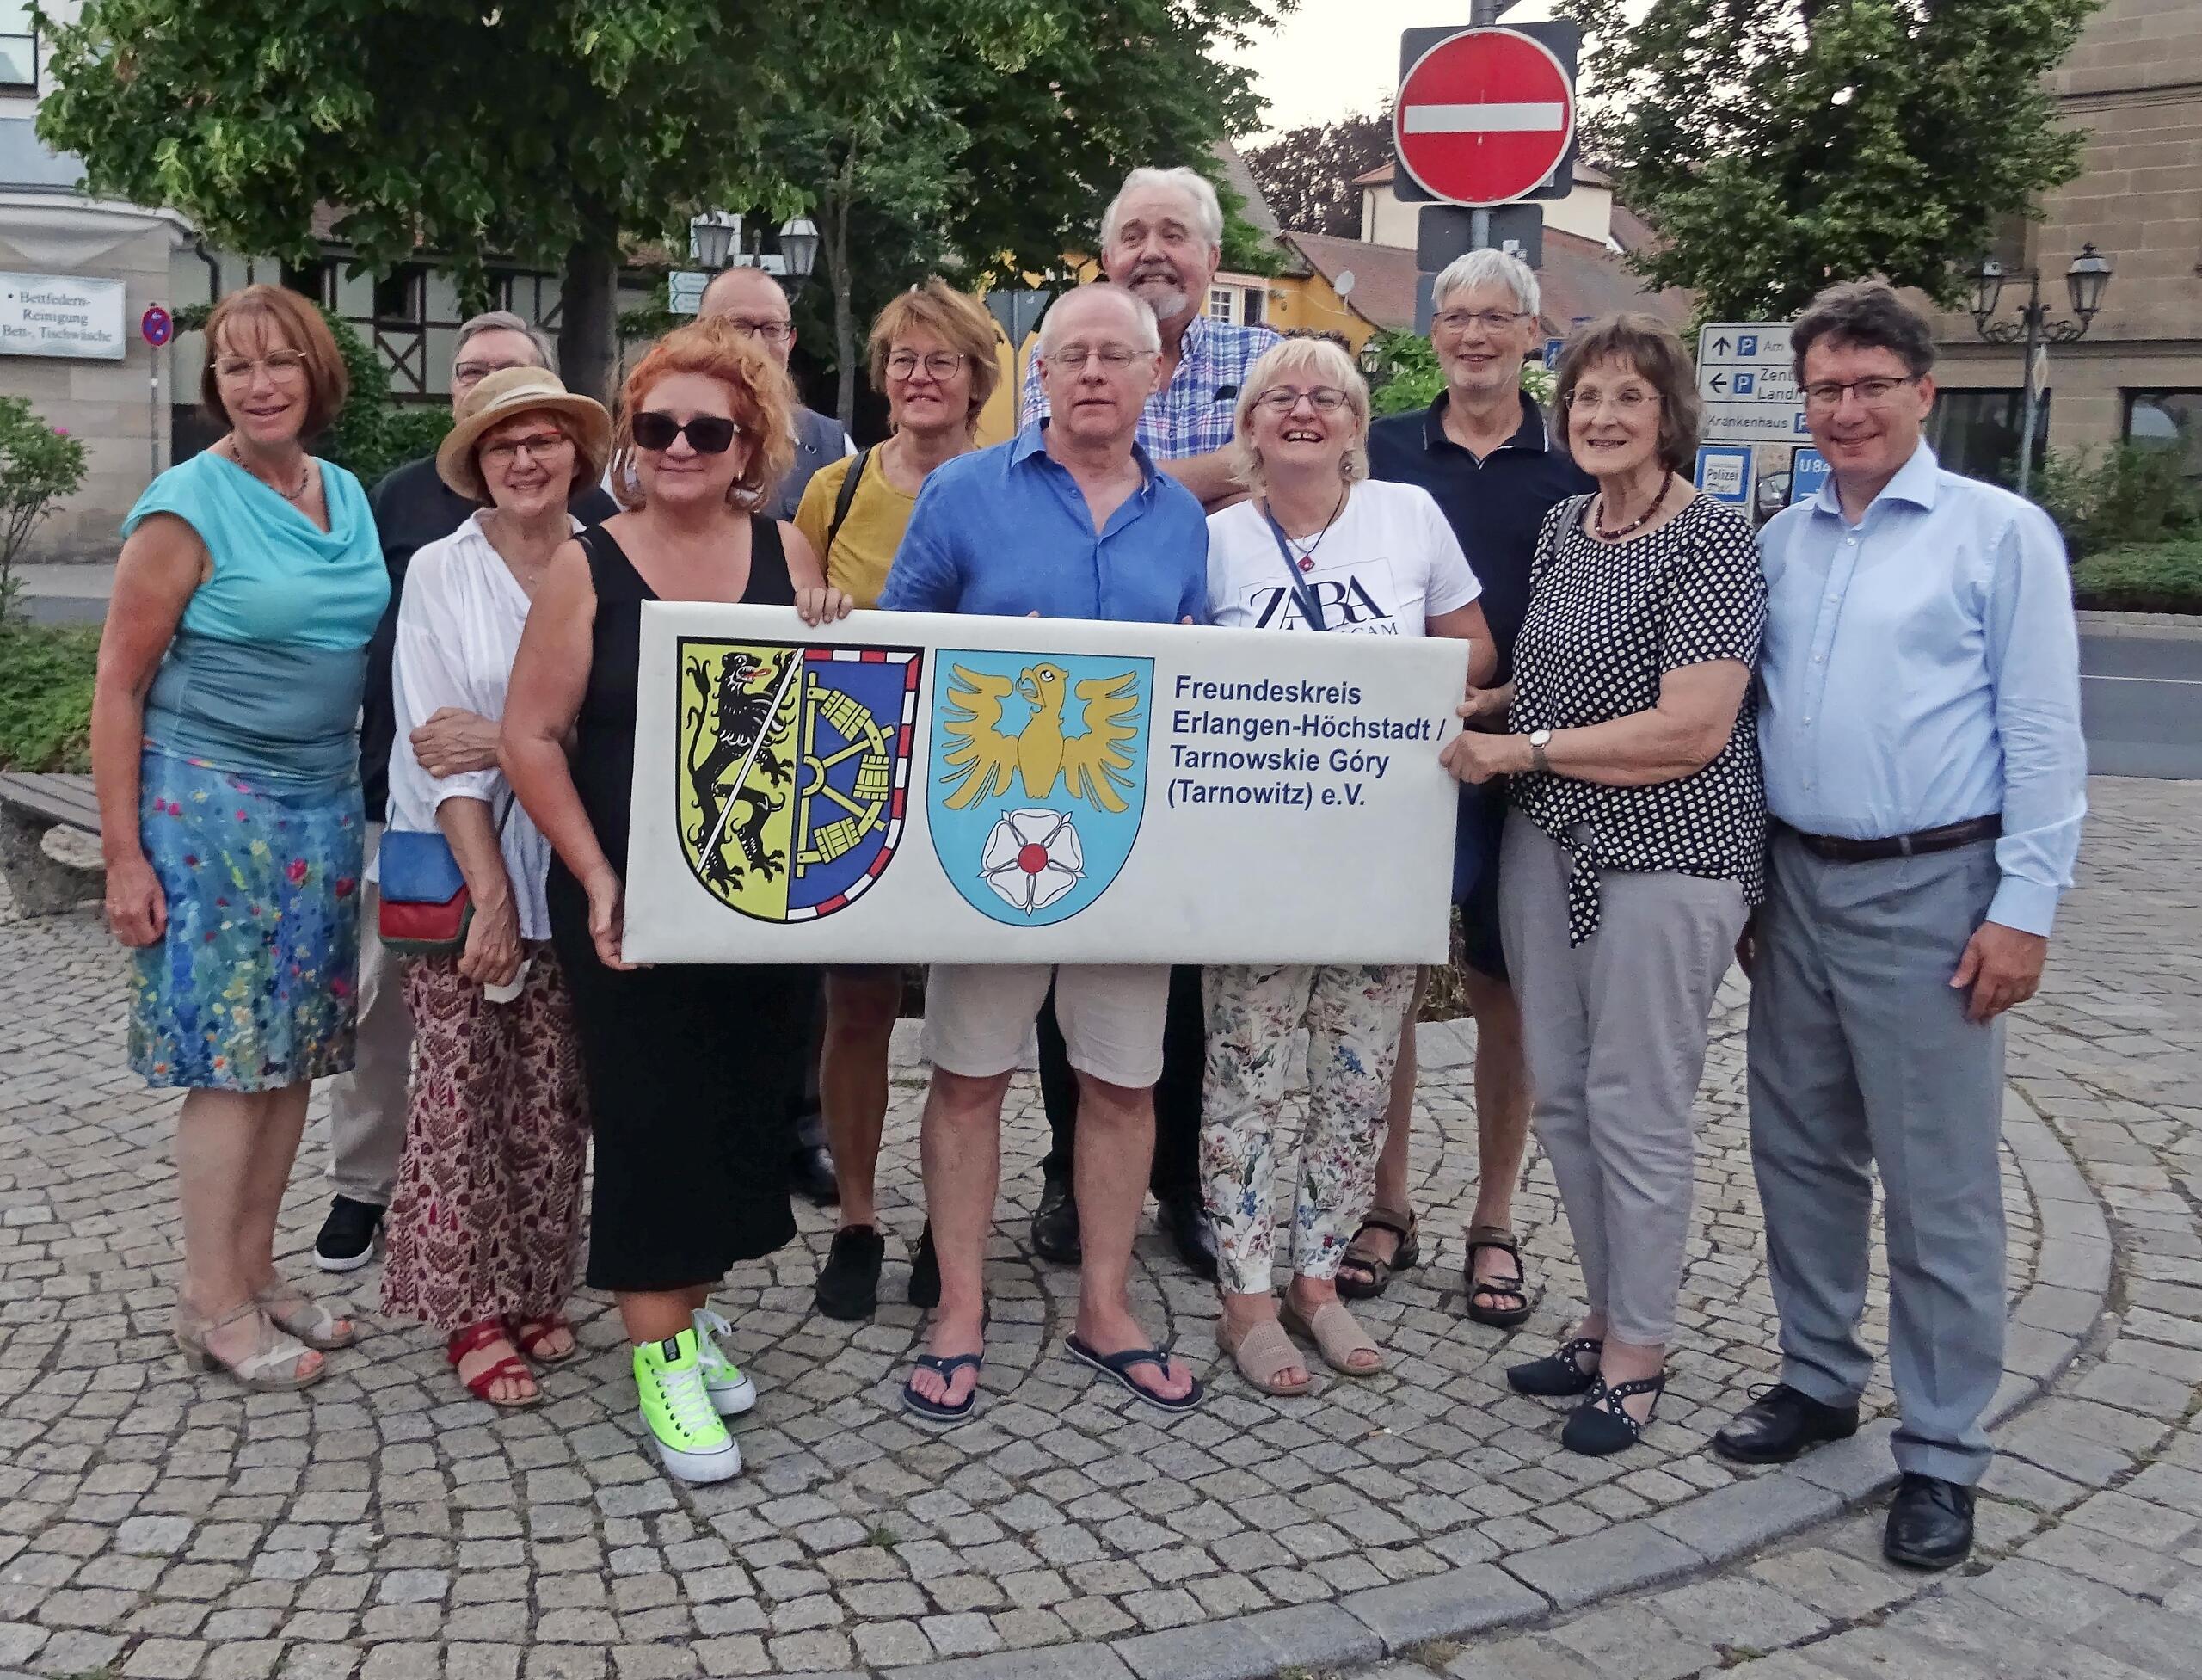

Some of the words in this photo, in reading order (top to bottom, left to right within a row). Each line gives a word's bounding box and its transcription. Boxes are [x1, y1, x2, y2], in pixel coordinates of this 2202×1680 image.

[1708, 415, 1788, 428] Krankenhaus
[1707, 468, 1739, 482] Polizei
[1175, 674, 1362, 705] Freundeskreis
[1172, 710, 1430, 742] Erlangen-Höchstadt
[1436, 718, 1446, 742] /
[1170, 744, 1320, 772] Tarnowskie
[1328, 749, 1390, 778] Góry
[1167, 778, 1313, 811] (Tarnowitz)
[1320, 783, 1366, 806] e.V.
